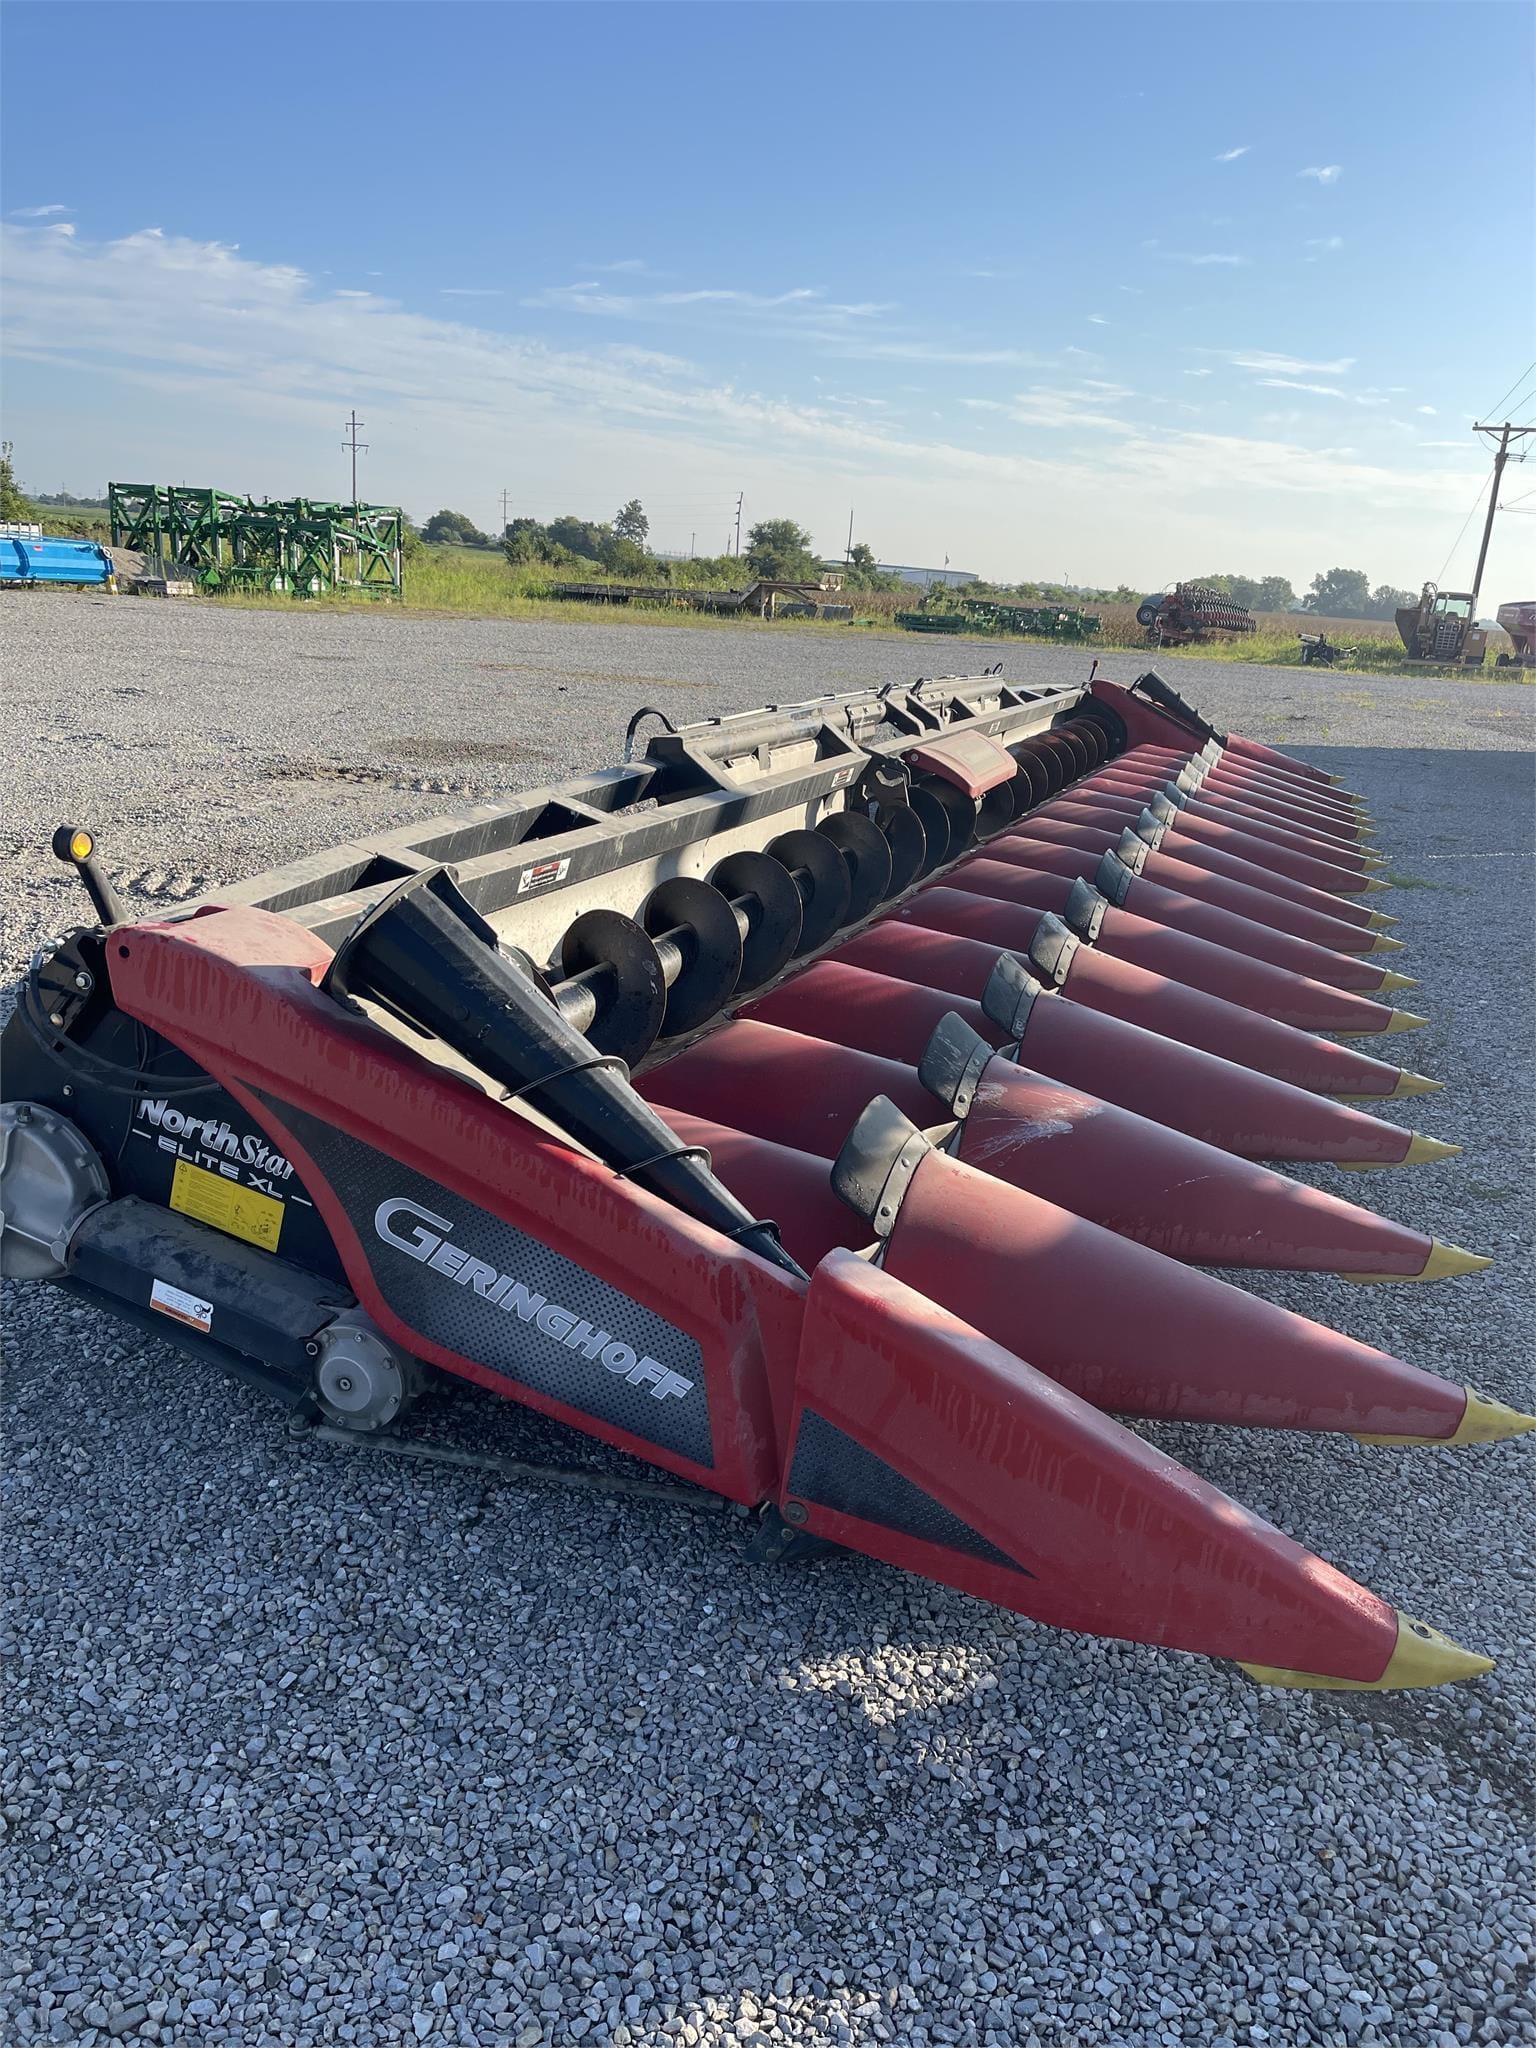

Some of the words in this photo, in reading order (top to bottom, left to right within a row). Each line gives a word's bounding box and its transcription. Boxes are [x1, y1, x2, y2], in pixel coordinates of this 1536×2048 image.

[137, 1099, 294, 1180] NorthStar
[158, 1135, 240, 1180] ELITE
[247, 1172, 283, 1198] XL
[374, 1197, 694, 1400] GERINGHOFF
